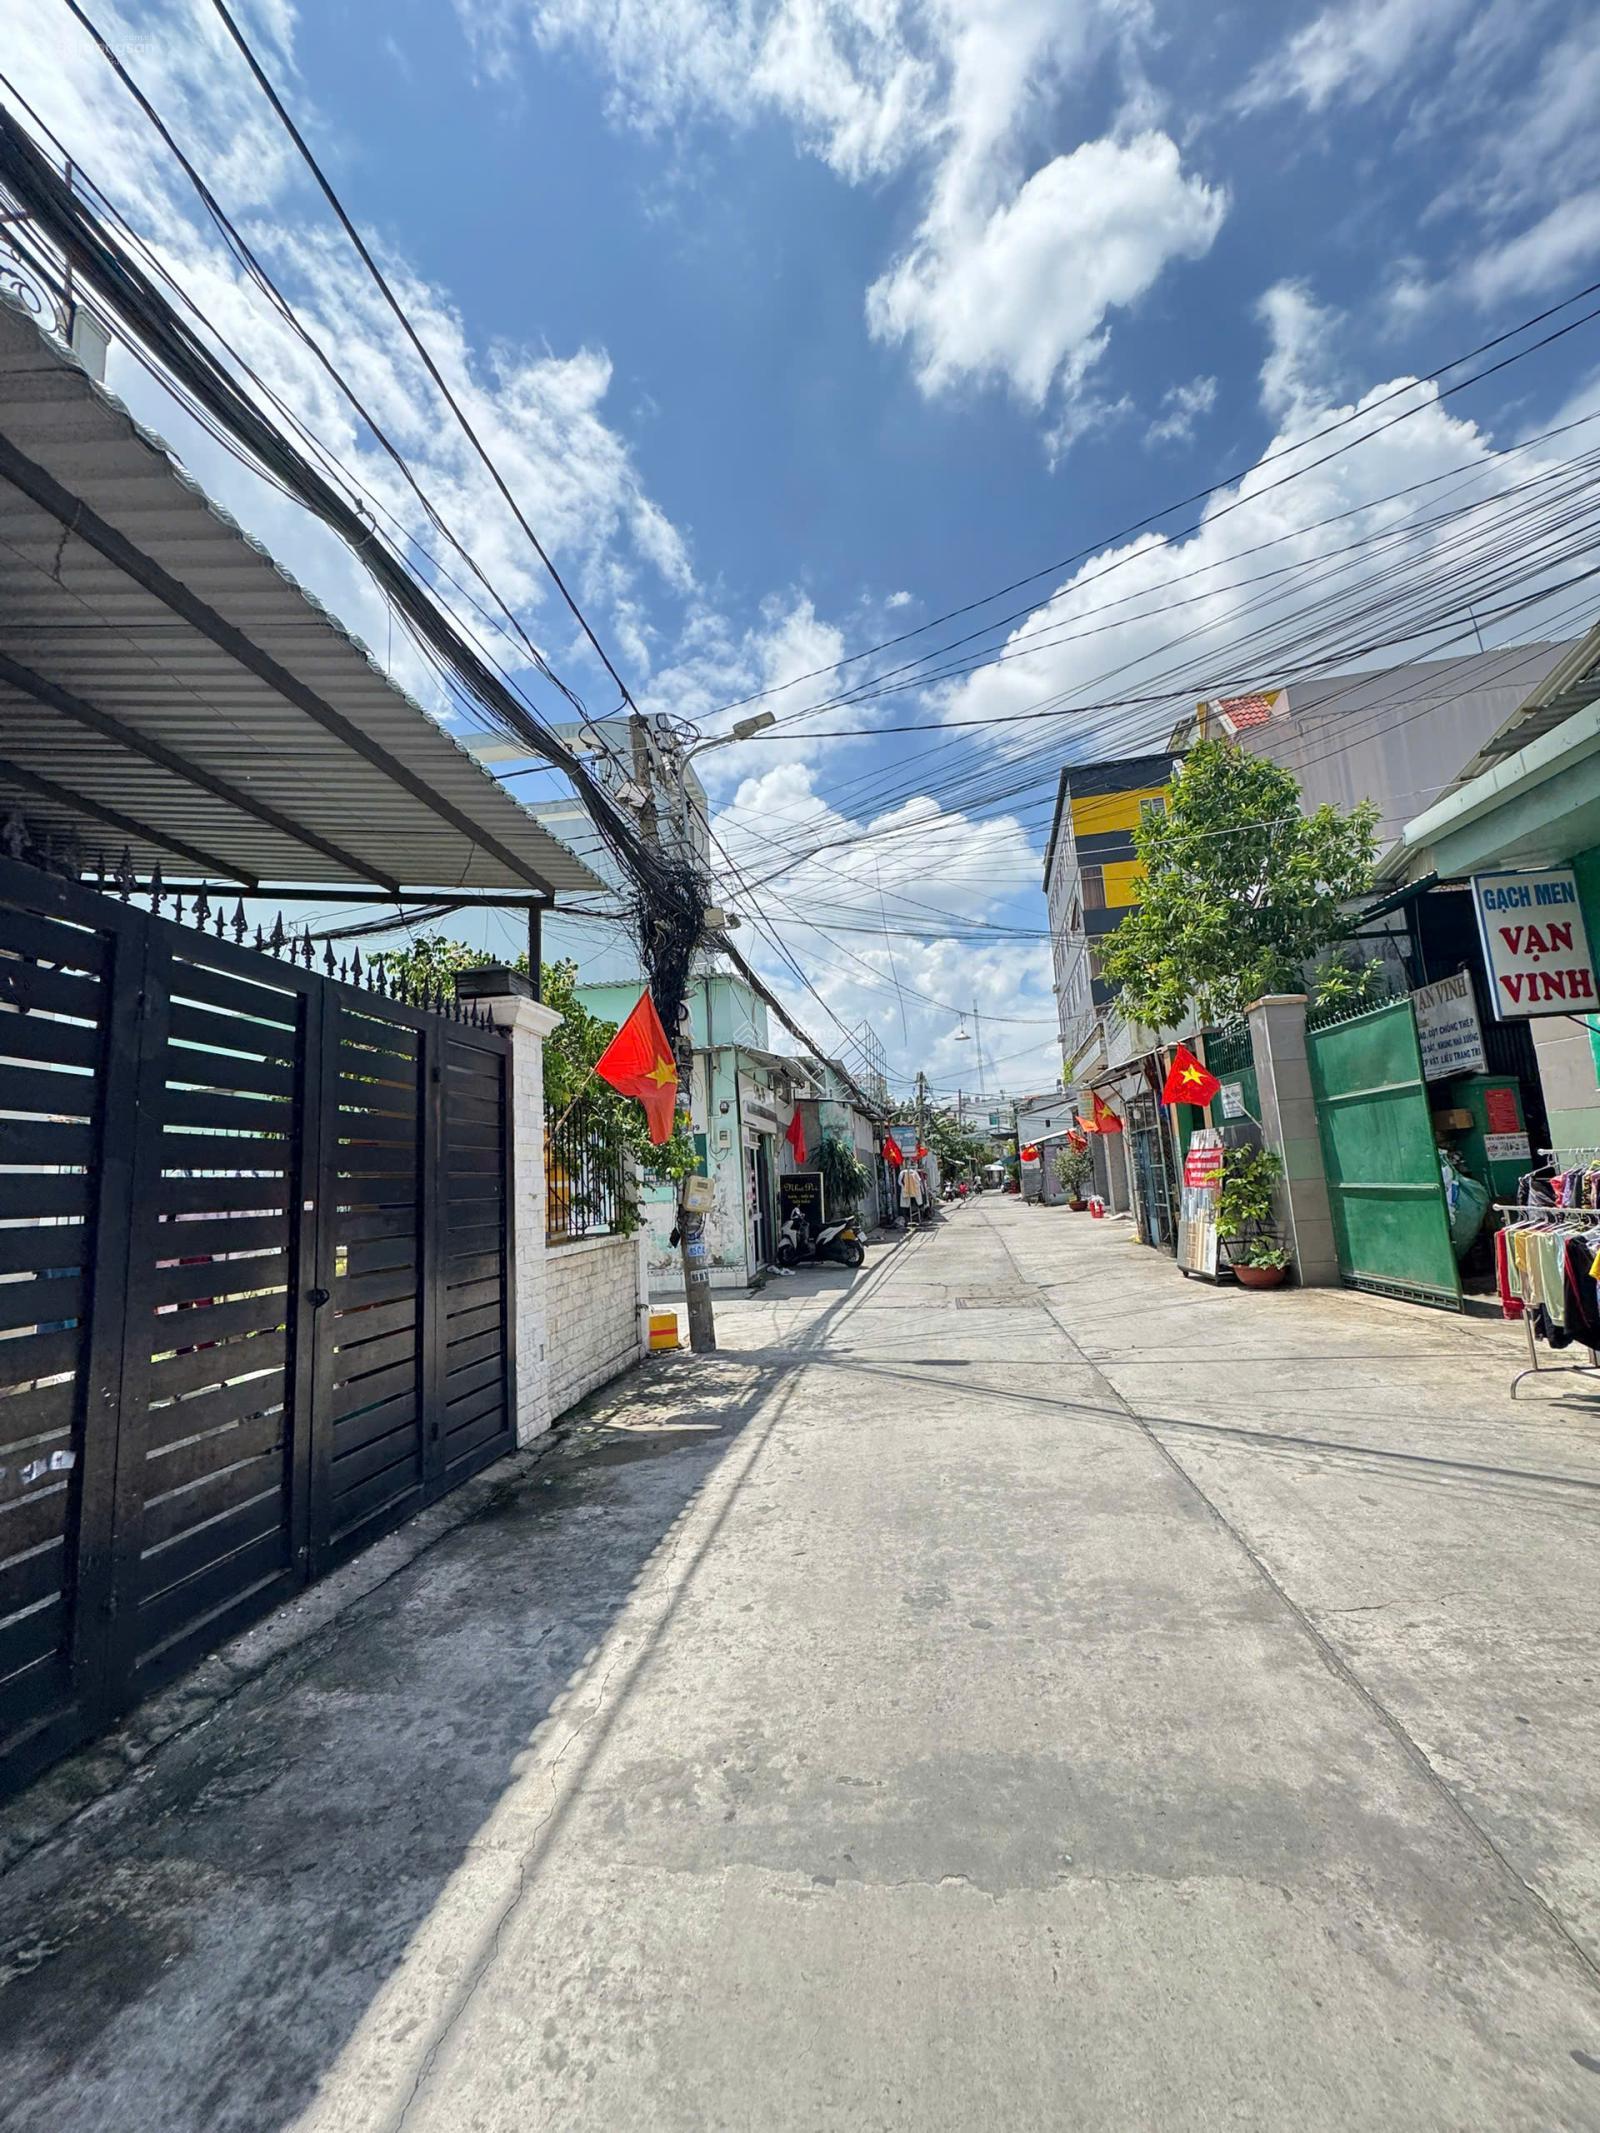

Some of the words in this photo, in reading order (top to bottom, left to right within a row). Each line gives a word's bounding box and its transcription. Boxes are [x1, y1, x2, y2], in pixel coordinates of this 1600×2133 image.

[1483, 885, 1532, 914] GẠCH
[1534, 882, 1576, 906] MEN
[1498, 922, 1573, 962] VẠN
[1435, 976, 1468, 1005] VINH
[1499, 969, 1594, 1003] VINH
